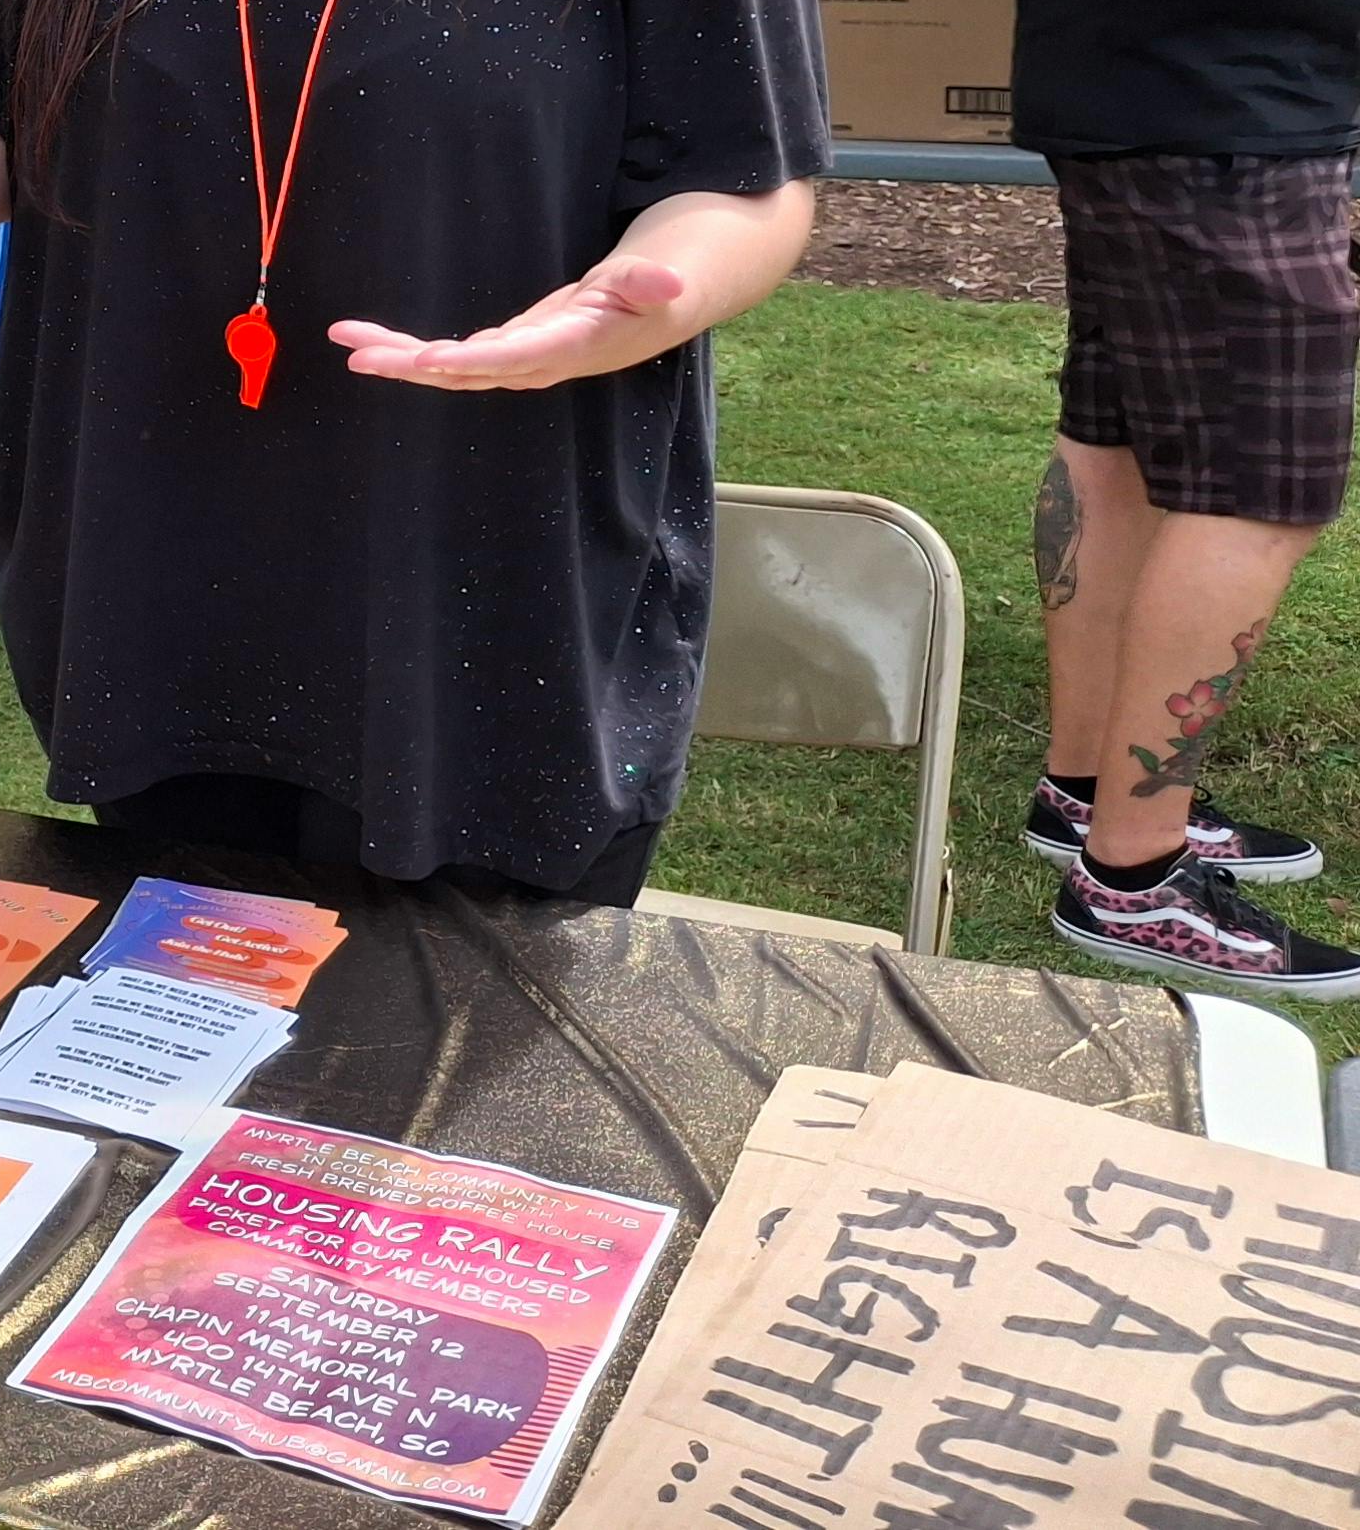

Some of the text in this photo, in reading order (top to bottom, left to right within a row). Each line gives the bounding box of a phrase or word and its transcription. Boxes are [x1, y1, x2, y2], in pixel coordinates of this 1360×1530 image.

[0, 898, 26, 913] HUB
[200, 1172, 610, 1283] HOUSING RALLY
[237, 1152, 615, 1251] FRESH BREWED COFFEE HOUSE
[243, 1126, 642, 1230] MYRTLE BEACH COMMUNITY HUB
[301, 1151, 554, 1221] IN COLLABORATION WITH
[1065, 1158, 1234, 1253] IS
[186, 1196, 592, 1307] PICKET FOR OUR UNHOUSED
[206, 1218, 543, 1320] COMMUNITY MEMBERS
[268, 1266, 441, 1328] SATURDAY
[211, 1270, 465, 1360] SEPTEMBER 12
[242, 1304, 406, 1368] 11AM-1PM
[1002, 1260, 1212, 1353] A
[114, 1297, 523, 1424] CHAPIN MEMORIAL PARK
[120, 1343, 451, 1458] MYRTLE BEACH, SC
[162, 1327, 437, 1429] 400 14TH AVE N
[48, 1367, 489, 1501] MBCOMMUNITYHUB@GMAIL.COM
